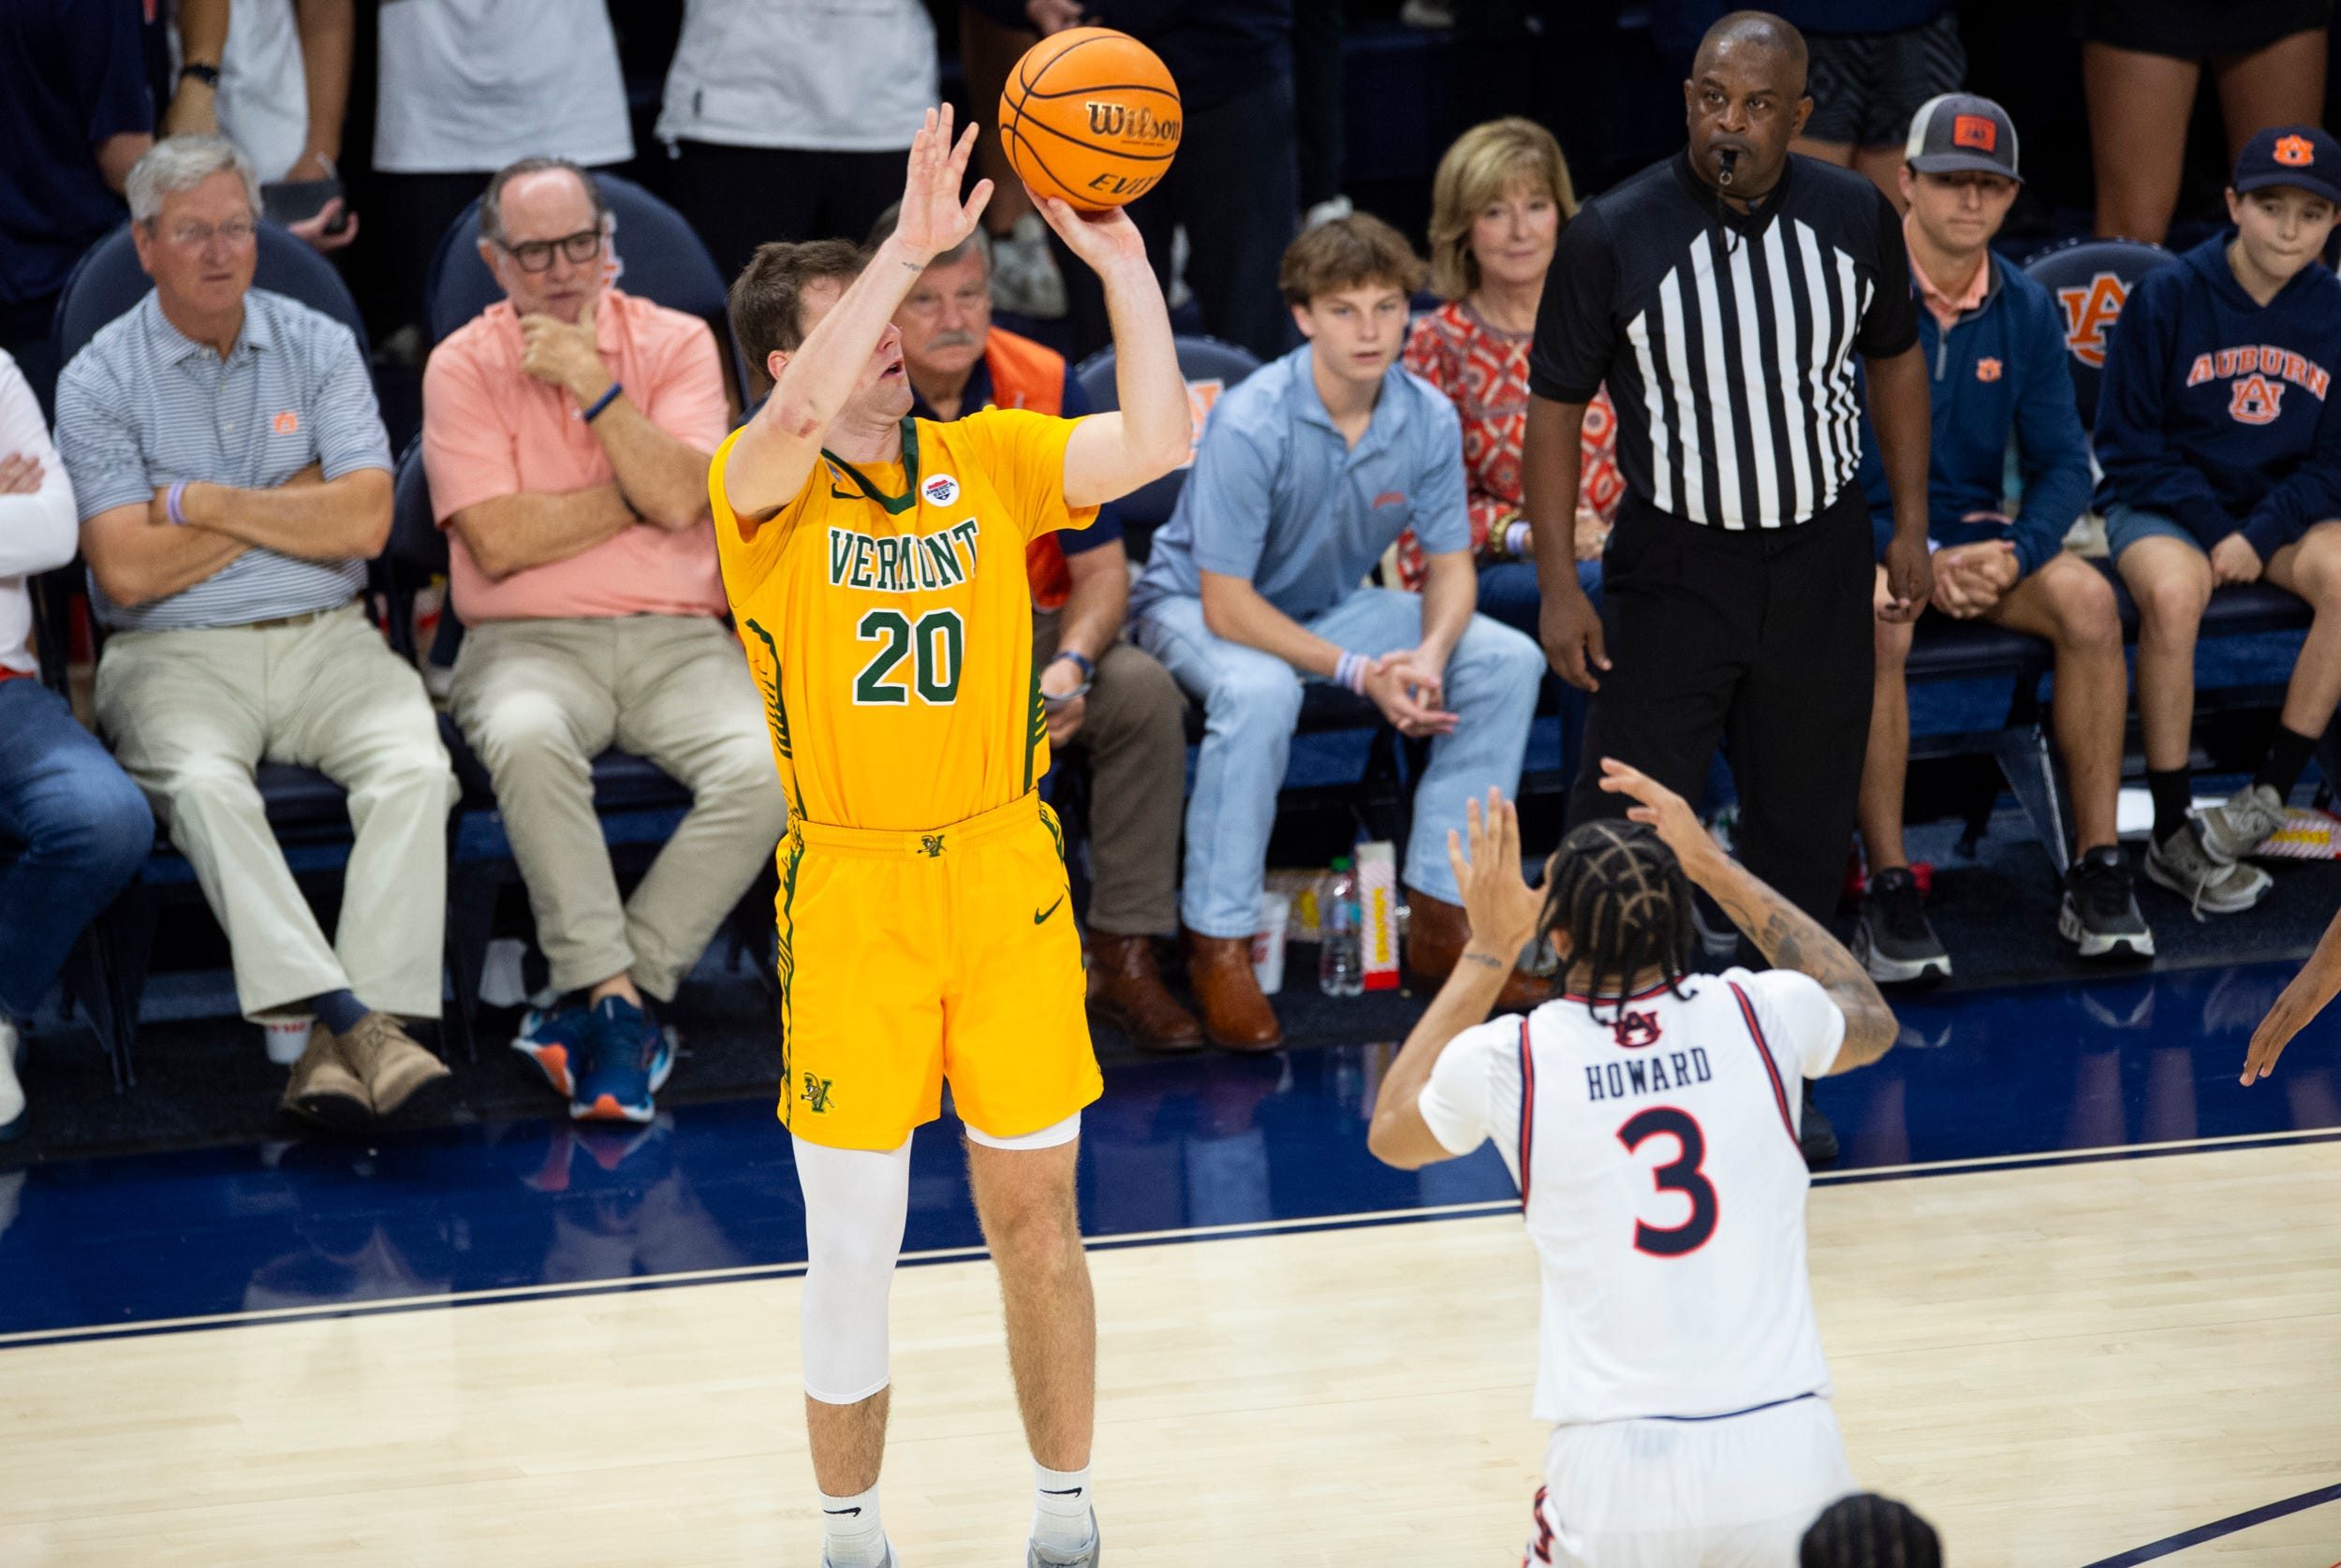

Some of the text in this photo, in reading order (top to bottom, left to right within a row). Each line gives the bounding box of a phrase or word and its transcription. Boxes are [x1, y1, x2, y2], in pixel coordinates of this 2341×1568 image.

[1086, 101, 1180, 141] Wilson
[2186, 344, 2331, 402] AUBURN
[852, 607, 964, 706] 20
[1585, 1047, 1712, 1101] HOWARD
[1615, 1106, 1719, 1258] 3
